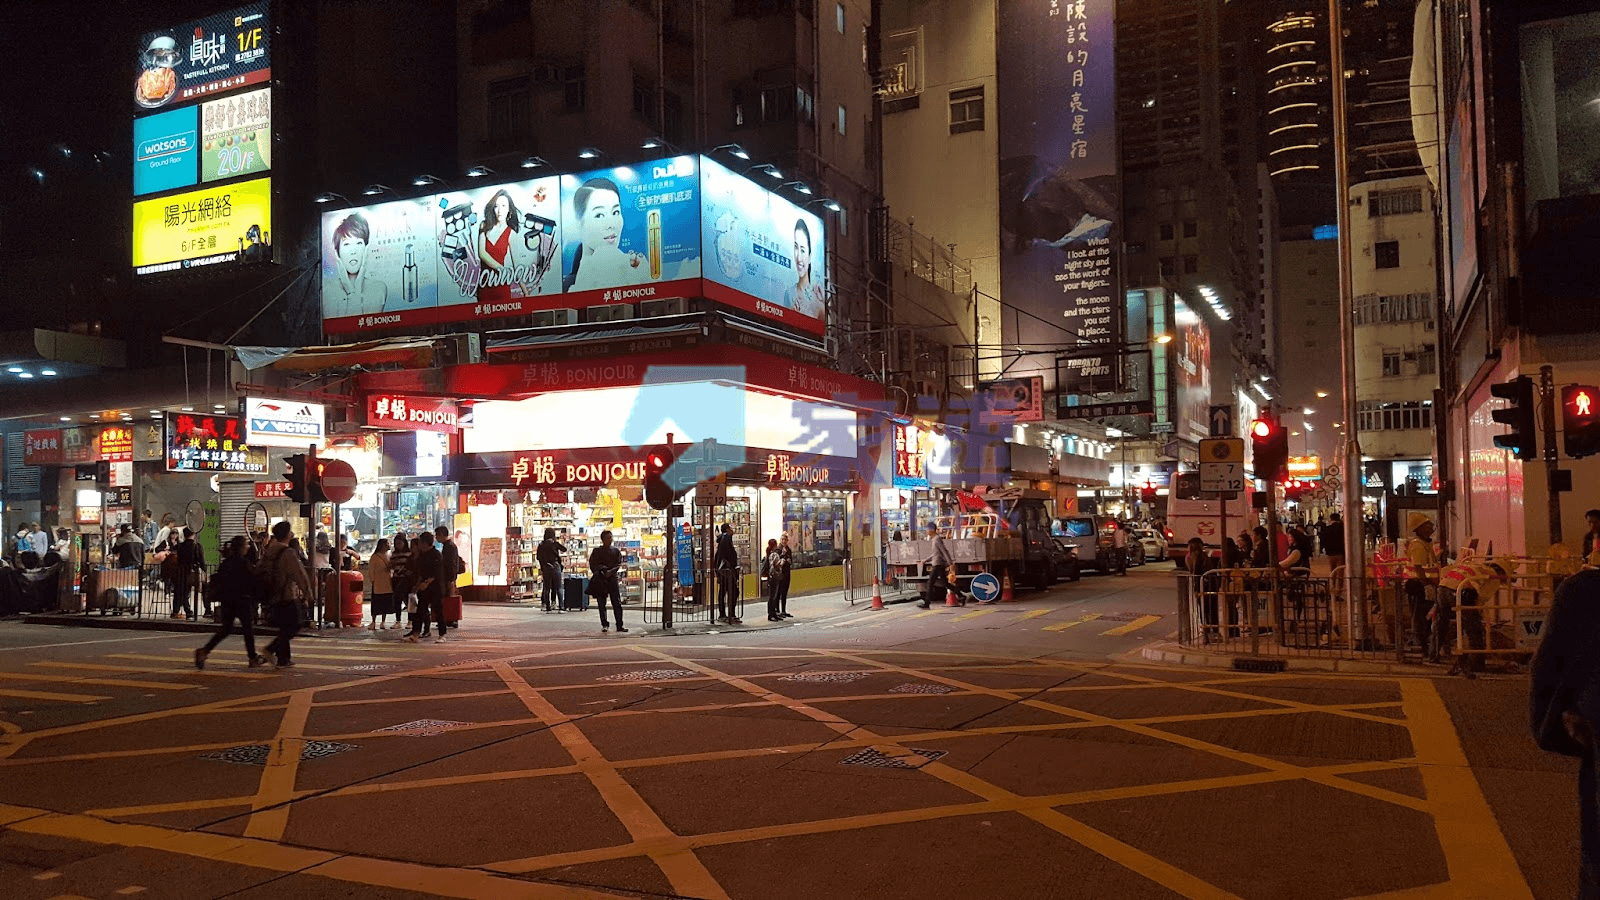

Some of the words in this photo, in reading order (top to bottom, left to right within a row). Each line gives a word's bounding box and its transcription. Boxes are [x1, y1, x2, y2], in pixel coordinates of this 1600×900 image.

[237, 28, 262, 52] 1/F
[145, 137, 187, 155] watsons
[150, 159, 169, 168] Ground
[170, 156, 181, 164] Floor
[218, 146, 254, 175] 20/F
[164, 194, 232, 228] 陽光網絡
[1087, 237, 1109, 246] When
[1072, 249, 1087, 258] look
[1088, 249, 1096, 257] at
[1097, 247, 1109, 255] the
[1064, 260, 1081, 272] night
[1083, 259, 1095, 269] sky
[1096, 257, 1109, 266] and
[1069, 271, 1081, 280] the
[1082, 269, 1100, 278] work
[1102, 267, 1111, 276] of
[623, 287, 655, 298] BONJOUR
[1063, 282, 1080, 293] your
[1076, 297, 1088, 305] the
[1090, 296, 1109, 304] moon
[492, 302, 522, 312] BONJOUR
[1064, 308, 1077, 317] and
[1078, 307, 1091, 316] the
[1092, 306, 1110, 314] stars
[374, 315, 401, 325] BONJOUR
[1084, 317, 1097, 327] you
[1099, 316, 1110, 324] set
[1067, 358, 1101, 369] TORONTO
[567, 365, 635, 384] BONJOUR
[1080, 366, 1109, 376] SPORTS
[811, 378, 841, 394] BONJOUR
[409, 409, 457, 425] BONJOUR
[270, 421, 319, 434] VICTOR
[226, 462, 244, 471] 2780
[246, 463, 262, 471] 1551
[1227, 464, 1234, 474] 7
[790, 466, 829, 485] BONJOUR
[1228, 480, 1240, 489] 12
[715, 496, 724, 504] 12
